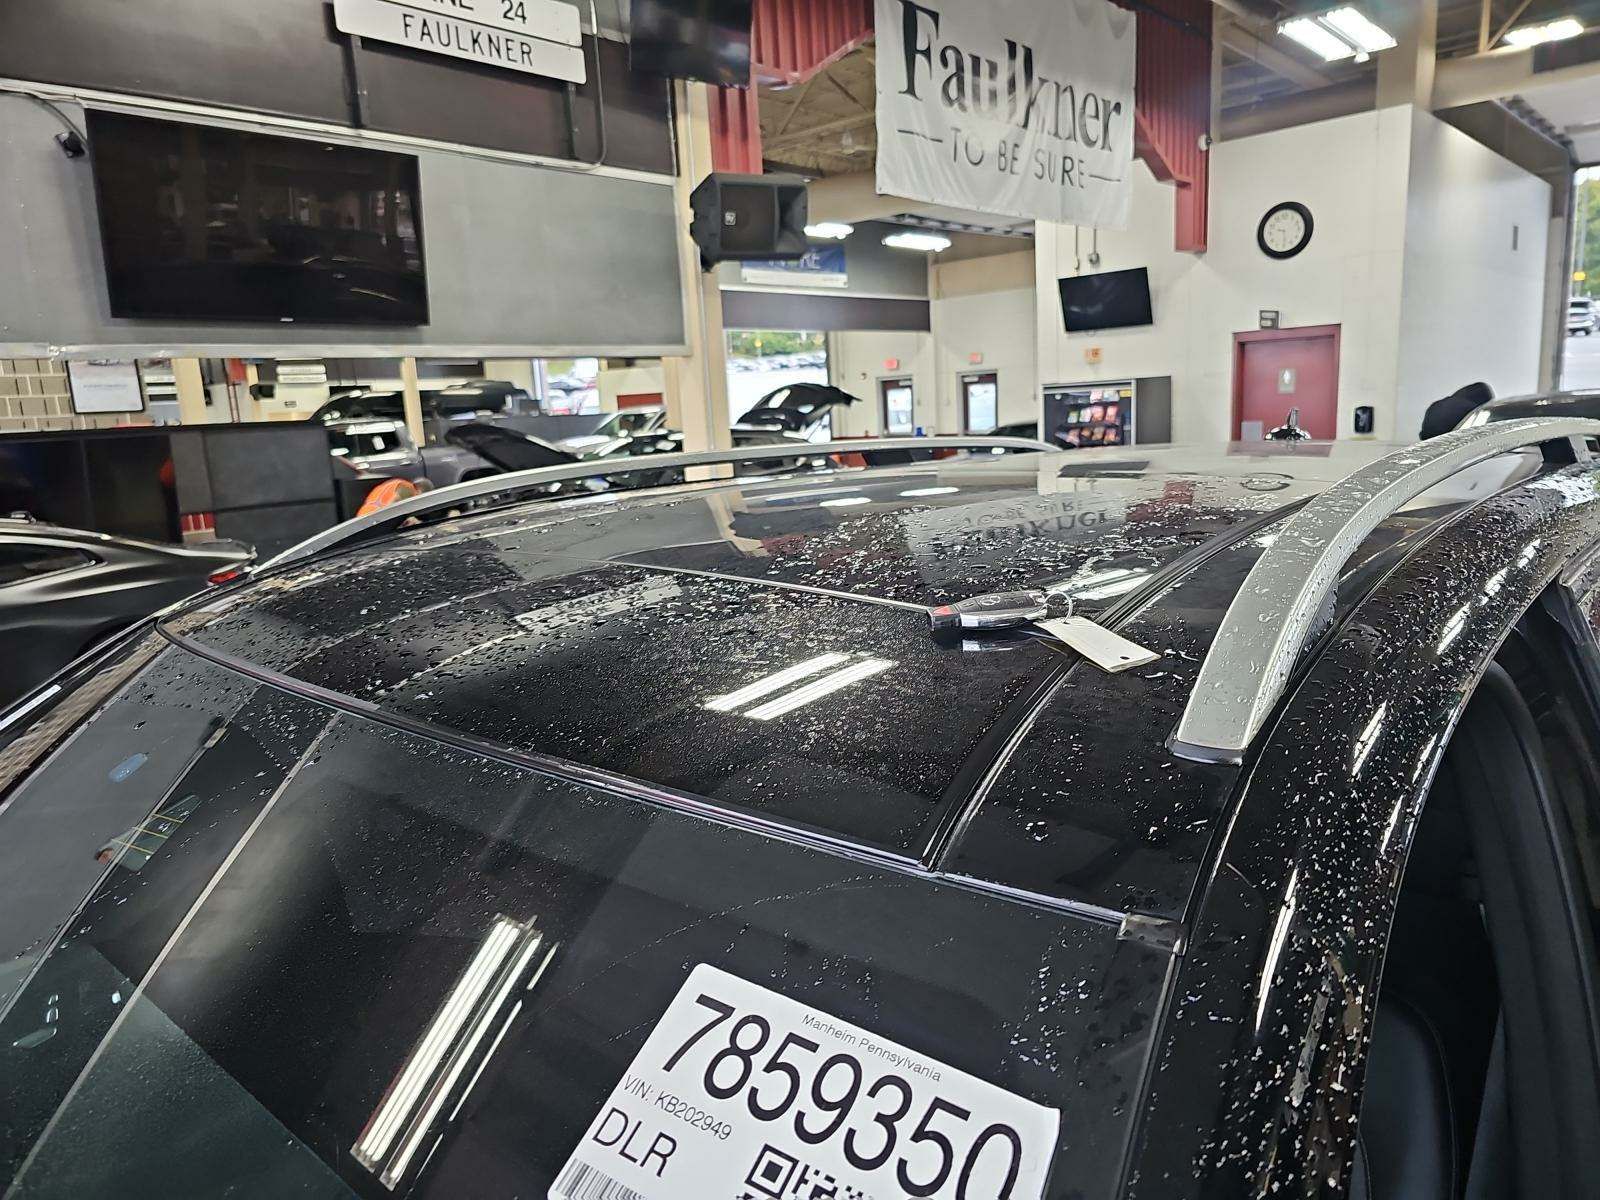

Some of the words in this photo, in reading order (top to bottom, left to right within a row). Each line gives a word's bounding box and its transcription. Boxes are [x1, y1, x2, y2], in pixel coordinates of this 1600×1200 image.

[402, 13, 534, 67] FAULKNER
[501, 0, 528, 24] 24
[898, 0, 1122, 152] Faulkner
[950, 126, 985, 166] TO
[996, 139, 1021, 176] BE
[1033, 148, 1085, 189] SURE
[801, 1013, 857, 1045] Manheim
[858, 1037, 943, 1082] Pennsylvania
[623, 1074, 655, 1102] VIN:
[654, 1090, 733, 1141] KB202949
[662, 993, 1023, 1200] 7859350
[592, 1106, 678, 1178] DLR
